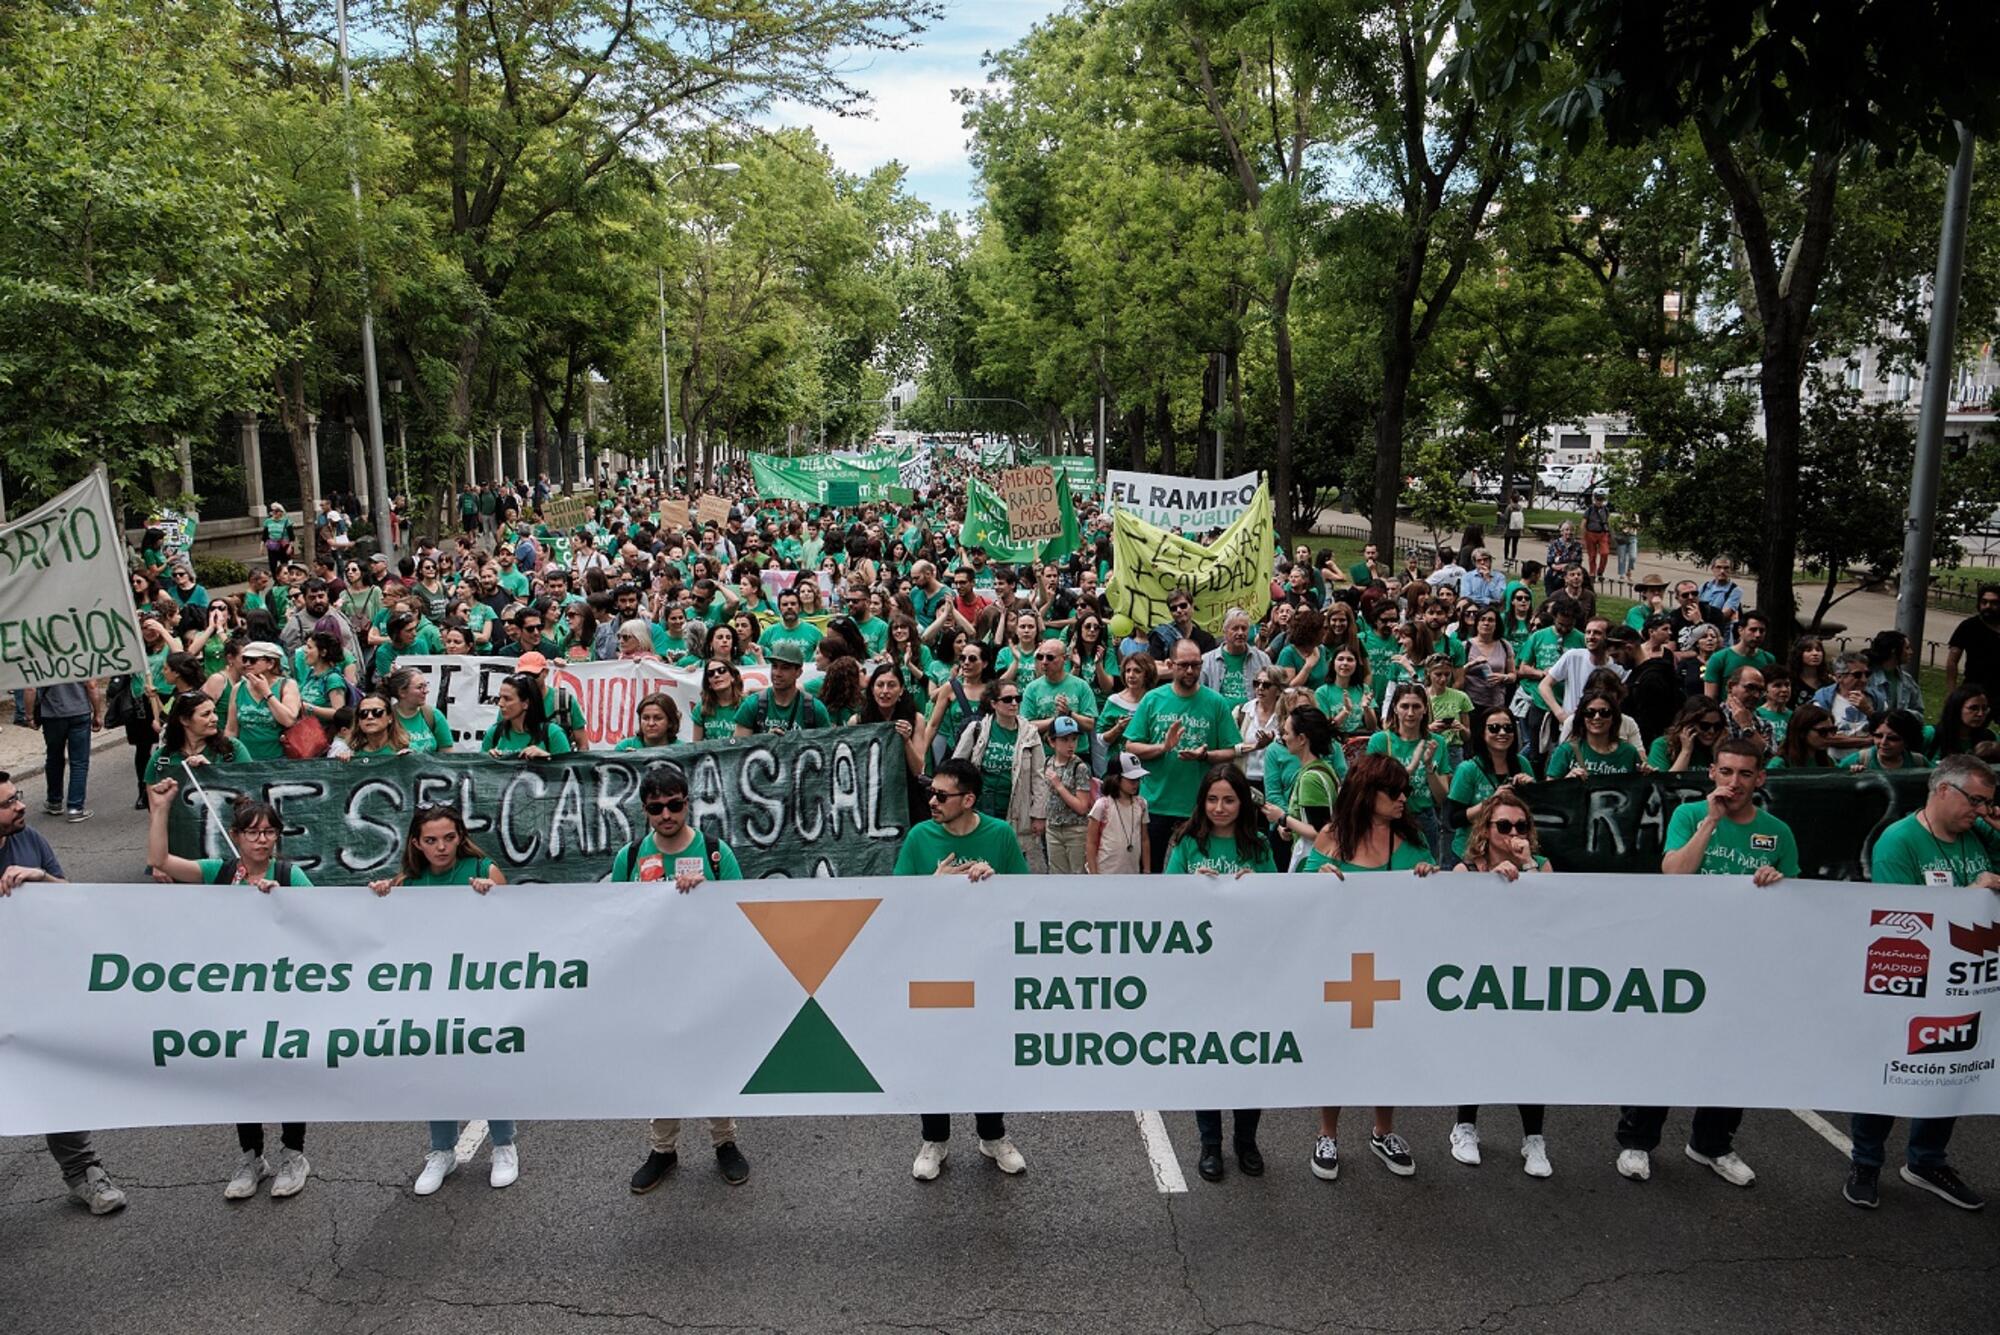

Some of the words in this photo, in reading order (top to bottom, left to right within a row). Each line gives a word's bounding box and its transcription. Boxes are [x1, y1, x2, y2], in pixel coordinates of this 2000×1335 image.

[1005, 469, 1053, 489] MENOS
[1009, 487, 1052, 511] RATIO
[1111, 481, 1141, 504] EL
[1150, 484, 1256, 510] RAMIRO
[1021, 503, 1047, 522] MÁS
[1149, 510, 1172, 527] LA
[1180, 507, 1244, 528] PÚBLIC
[1012, 517, 1062, 540] EDUCACIÓN
[1158, 556, 1258, 598] CALIDAD
[18, 646, 132, 684] HIJOS/AS
[498, 738, 902, 866] CARASCAL
[1015, 920, 1213, 955] LECTIVAS
[1869, 949, 1929, 960] enseñanza
[88, 951, 354, 994] Docentes
[368, 962, 434, 993] en
[448, 952, 590, 992] lucha
[1871, 962, 1922, 974] MADRID
[1015, 976, 1148, 1011] RATIO
[1428, 965, 1707, 1014] CALIDAD
[1869, 974, 1924, 995] CGT
[153, 1029, 248, 1069] por
[262, 1021, 310, 1060] la
[327, 1018, 526, 1070] pública
[1919, 1024, 1972, 1045] CNT
[1015, 1031, 1304, 1067] BUROCRACIA
[1891, 1059, 1945, 1075] Sección
[1949, 1058, 1996, 1075] Sindical
[1889, 1075, 1935, 1087] Educación
[1935, 1076, 1963, 1087] Pública
